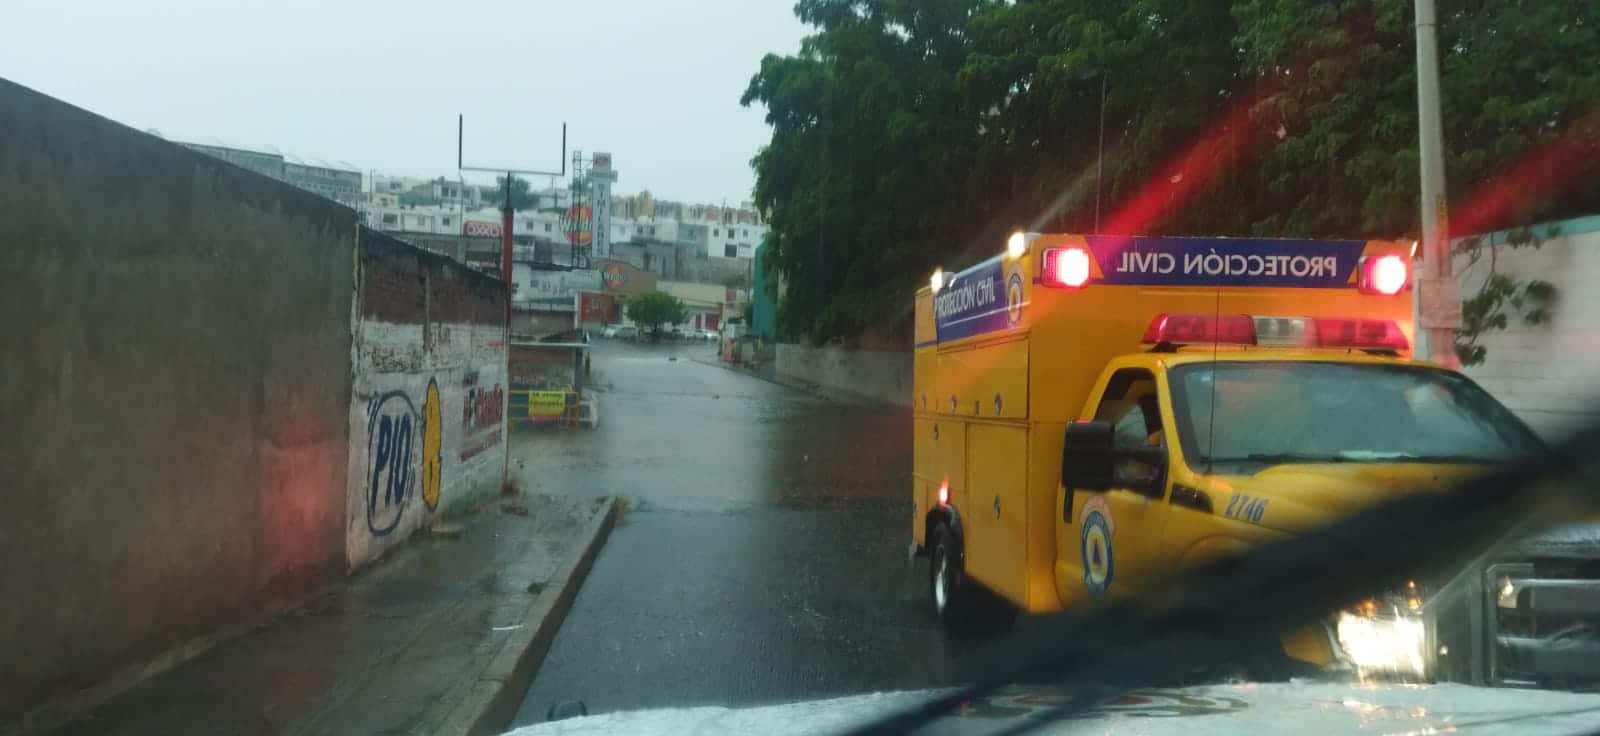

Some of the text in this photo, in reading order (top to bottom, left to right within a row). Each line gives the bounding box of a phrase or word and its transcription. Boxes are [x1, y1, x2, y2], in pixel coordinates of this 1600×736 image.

[466, 223, 500, 238] OXXO
[976, 276, 996, 307] CIVIL
[1224, 492, 1269, 524] 2746
